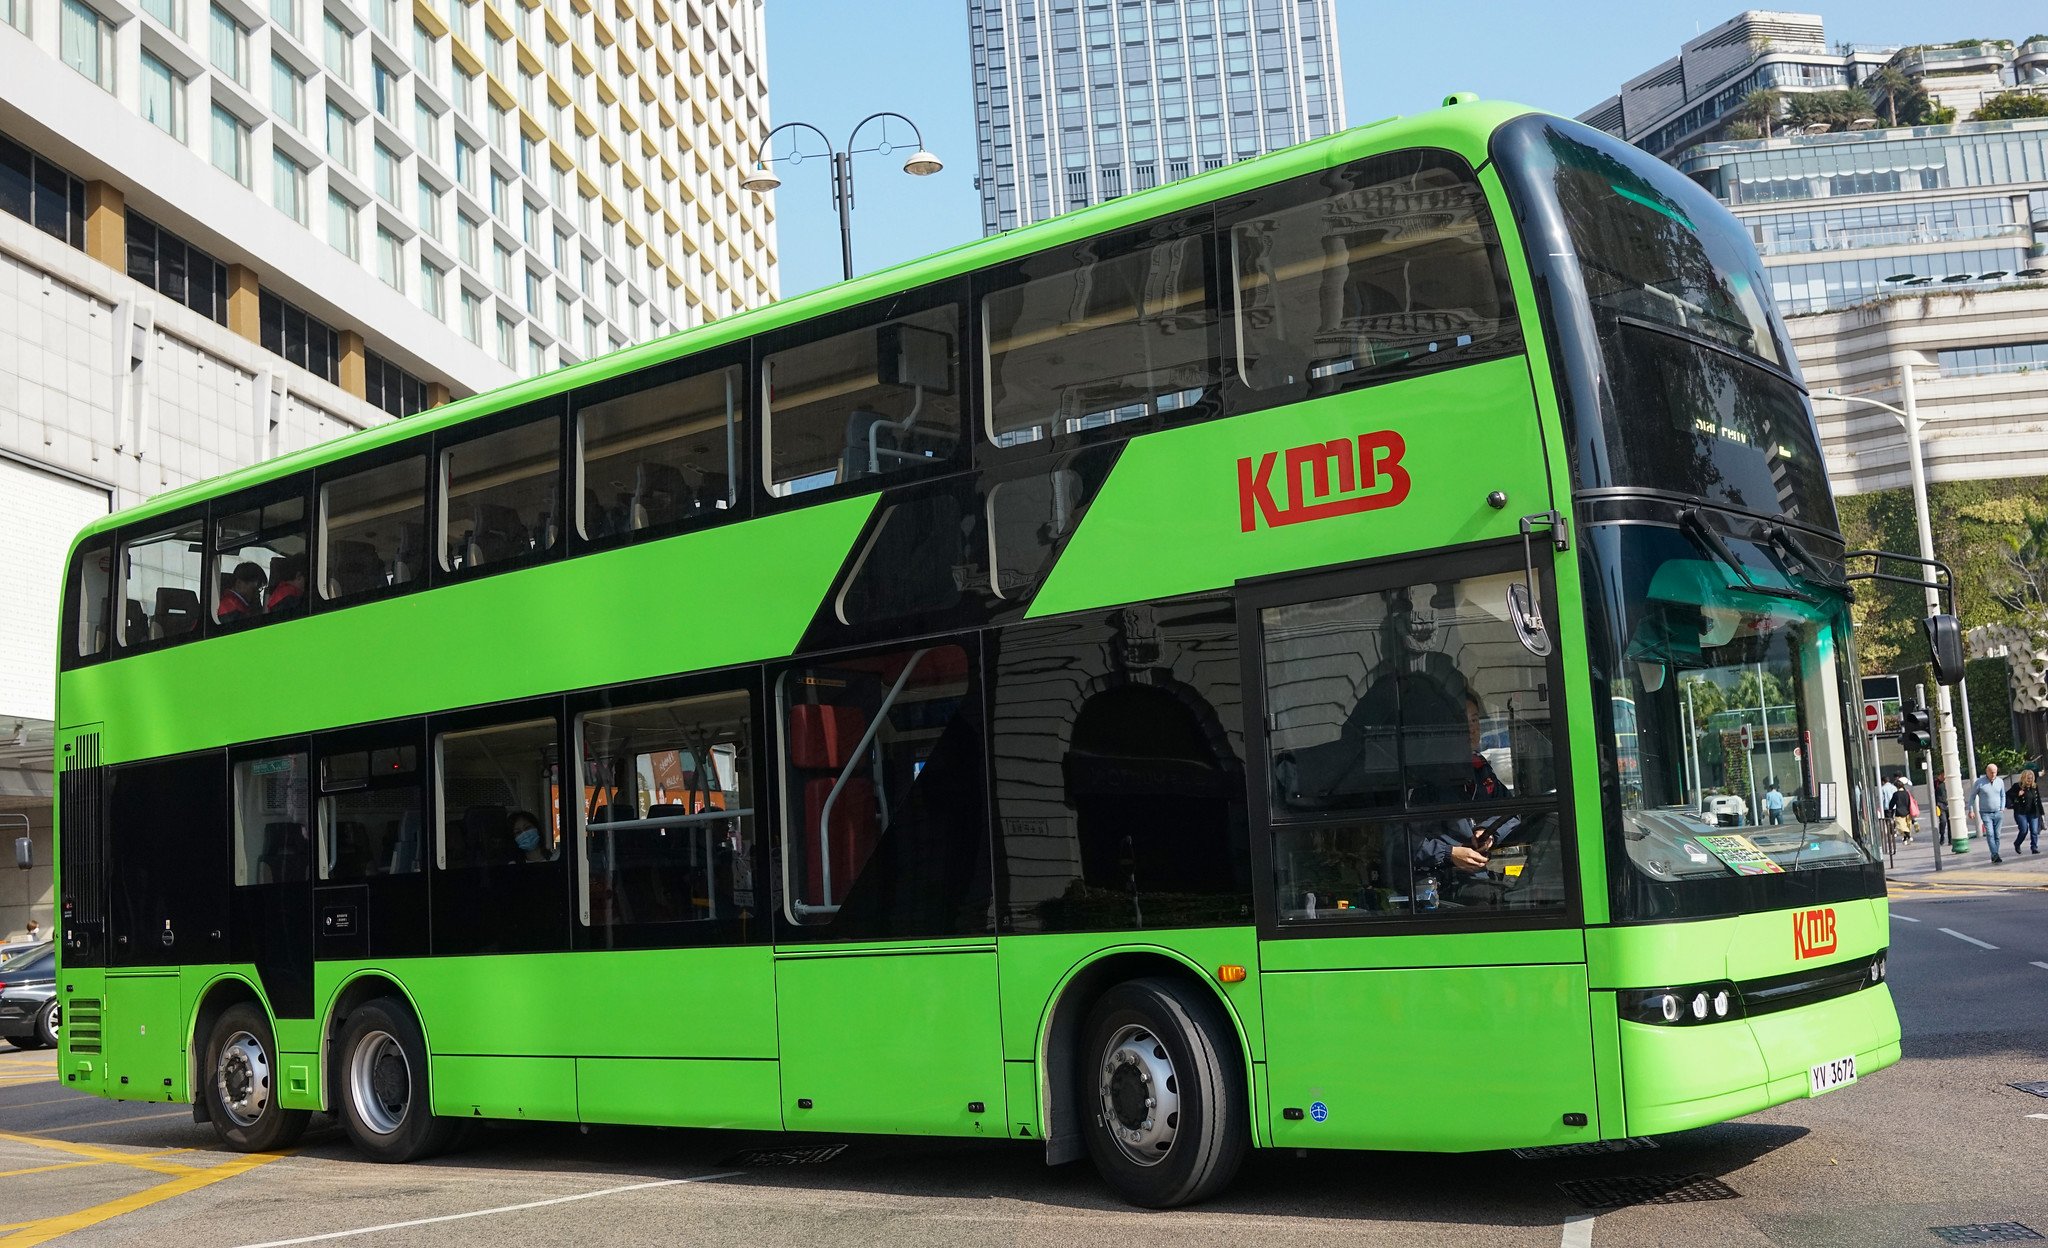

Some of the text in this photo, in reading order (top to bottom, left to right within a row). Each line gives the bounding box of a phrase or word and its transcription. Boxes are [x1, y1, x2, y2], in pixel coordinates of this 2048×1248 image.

[1237, 430, 1411, 533] KMB
[1793, 908, 1837, 960] KMB
[1813, 1058, 1854, 1089] YV 3672
